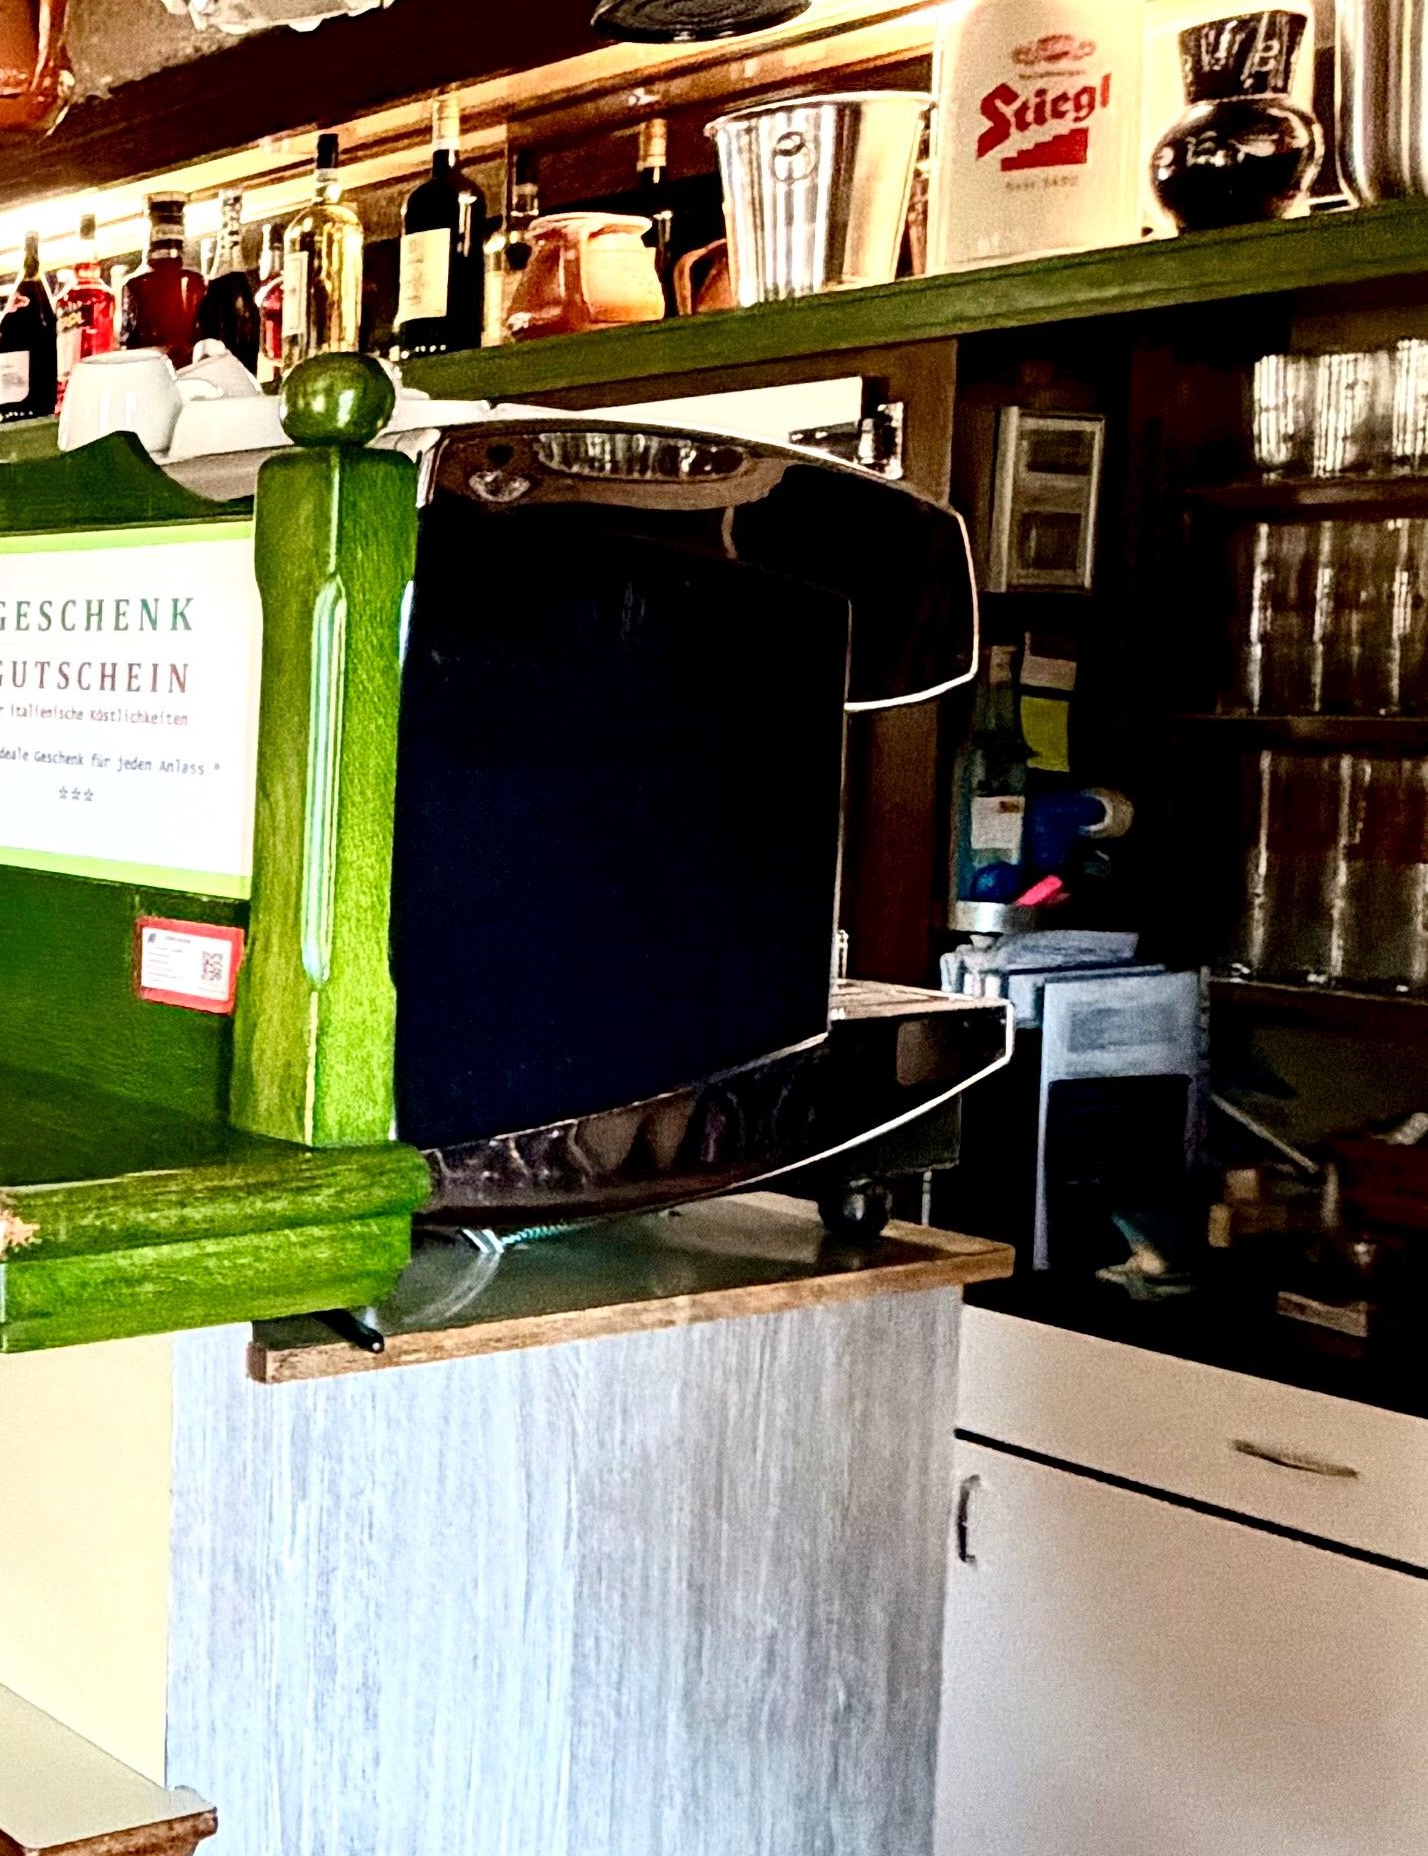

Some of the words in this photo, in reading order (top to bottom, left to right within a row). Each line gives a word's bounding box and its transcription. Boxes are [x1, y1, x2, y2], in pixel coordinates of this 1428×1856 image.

[976, 72, 1112, 161] Stiegl
[10, 703, 84, 721] italienische
[90, 709, 189, 726] Köstlichkeiten
[34, 750, 84, 766] Geschenk
[91, 753, 111, 769] für
[117, 756, 152, 773] jeden
[159, 759, 205, 776] Anlass
